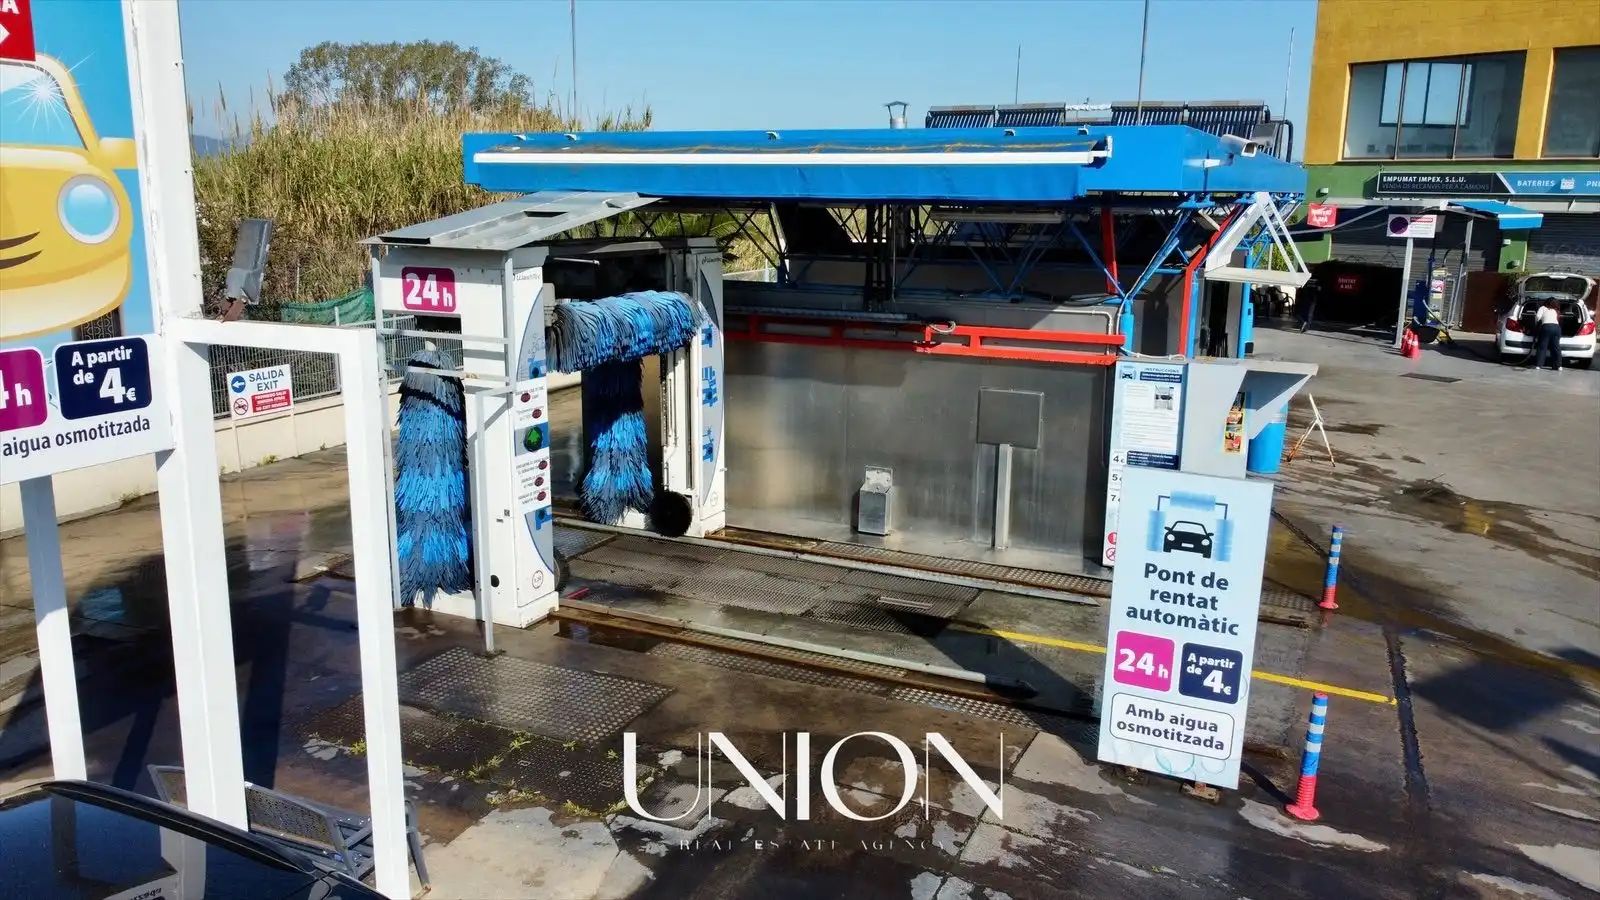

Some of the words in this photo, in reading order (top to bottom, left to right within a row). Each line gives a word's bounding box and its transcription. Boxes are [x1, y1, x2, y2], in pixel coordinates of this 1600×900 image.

[1383, 175, 1417, 183] EMPUMAT
[1418, 176, 1443, 184] IMPEX,
[1517, 179, 1556, 187] BATERIES
[405, 272, 440, 306] 24
[71, 351, 84, 367] A
[86, 345, 133, 368] partir
[73, 369, 95, 386] de
[249, 369, 284, 382] SALIDA
[257, 381, 278, 391] EXIT
[2, 435, 51, 459] aigua
[55, 415, 150, 447] osmotitzada
[1113, 455, 1120, 463] 4
[1144, 562, 1196, 586] Pont
[1200, 571, 1229, 591] de
[1150, 588, 1219, 611] rentat
[1126, 605, 1239, 636] automàtic
[1186, 664, 1203, 675] de
[1187, 652, 1197, 663] A
[1199, 655, 1236, 669] partir
[1125, 703, 1165, 722] Amb
[1169, 713, 1218, 733] aigua
[1116, 720, 1225, 751] osmotitzada
